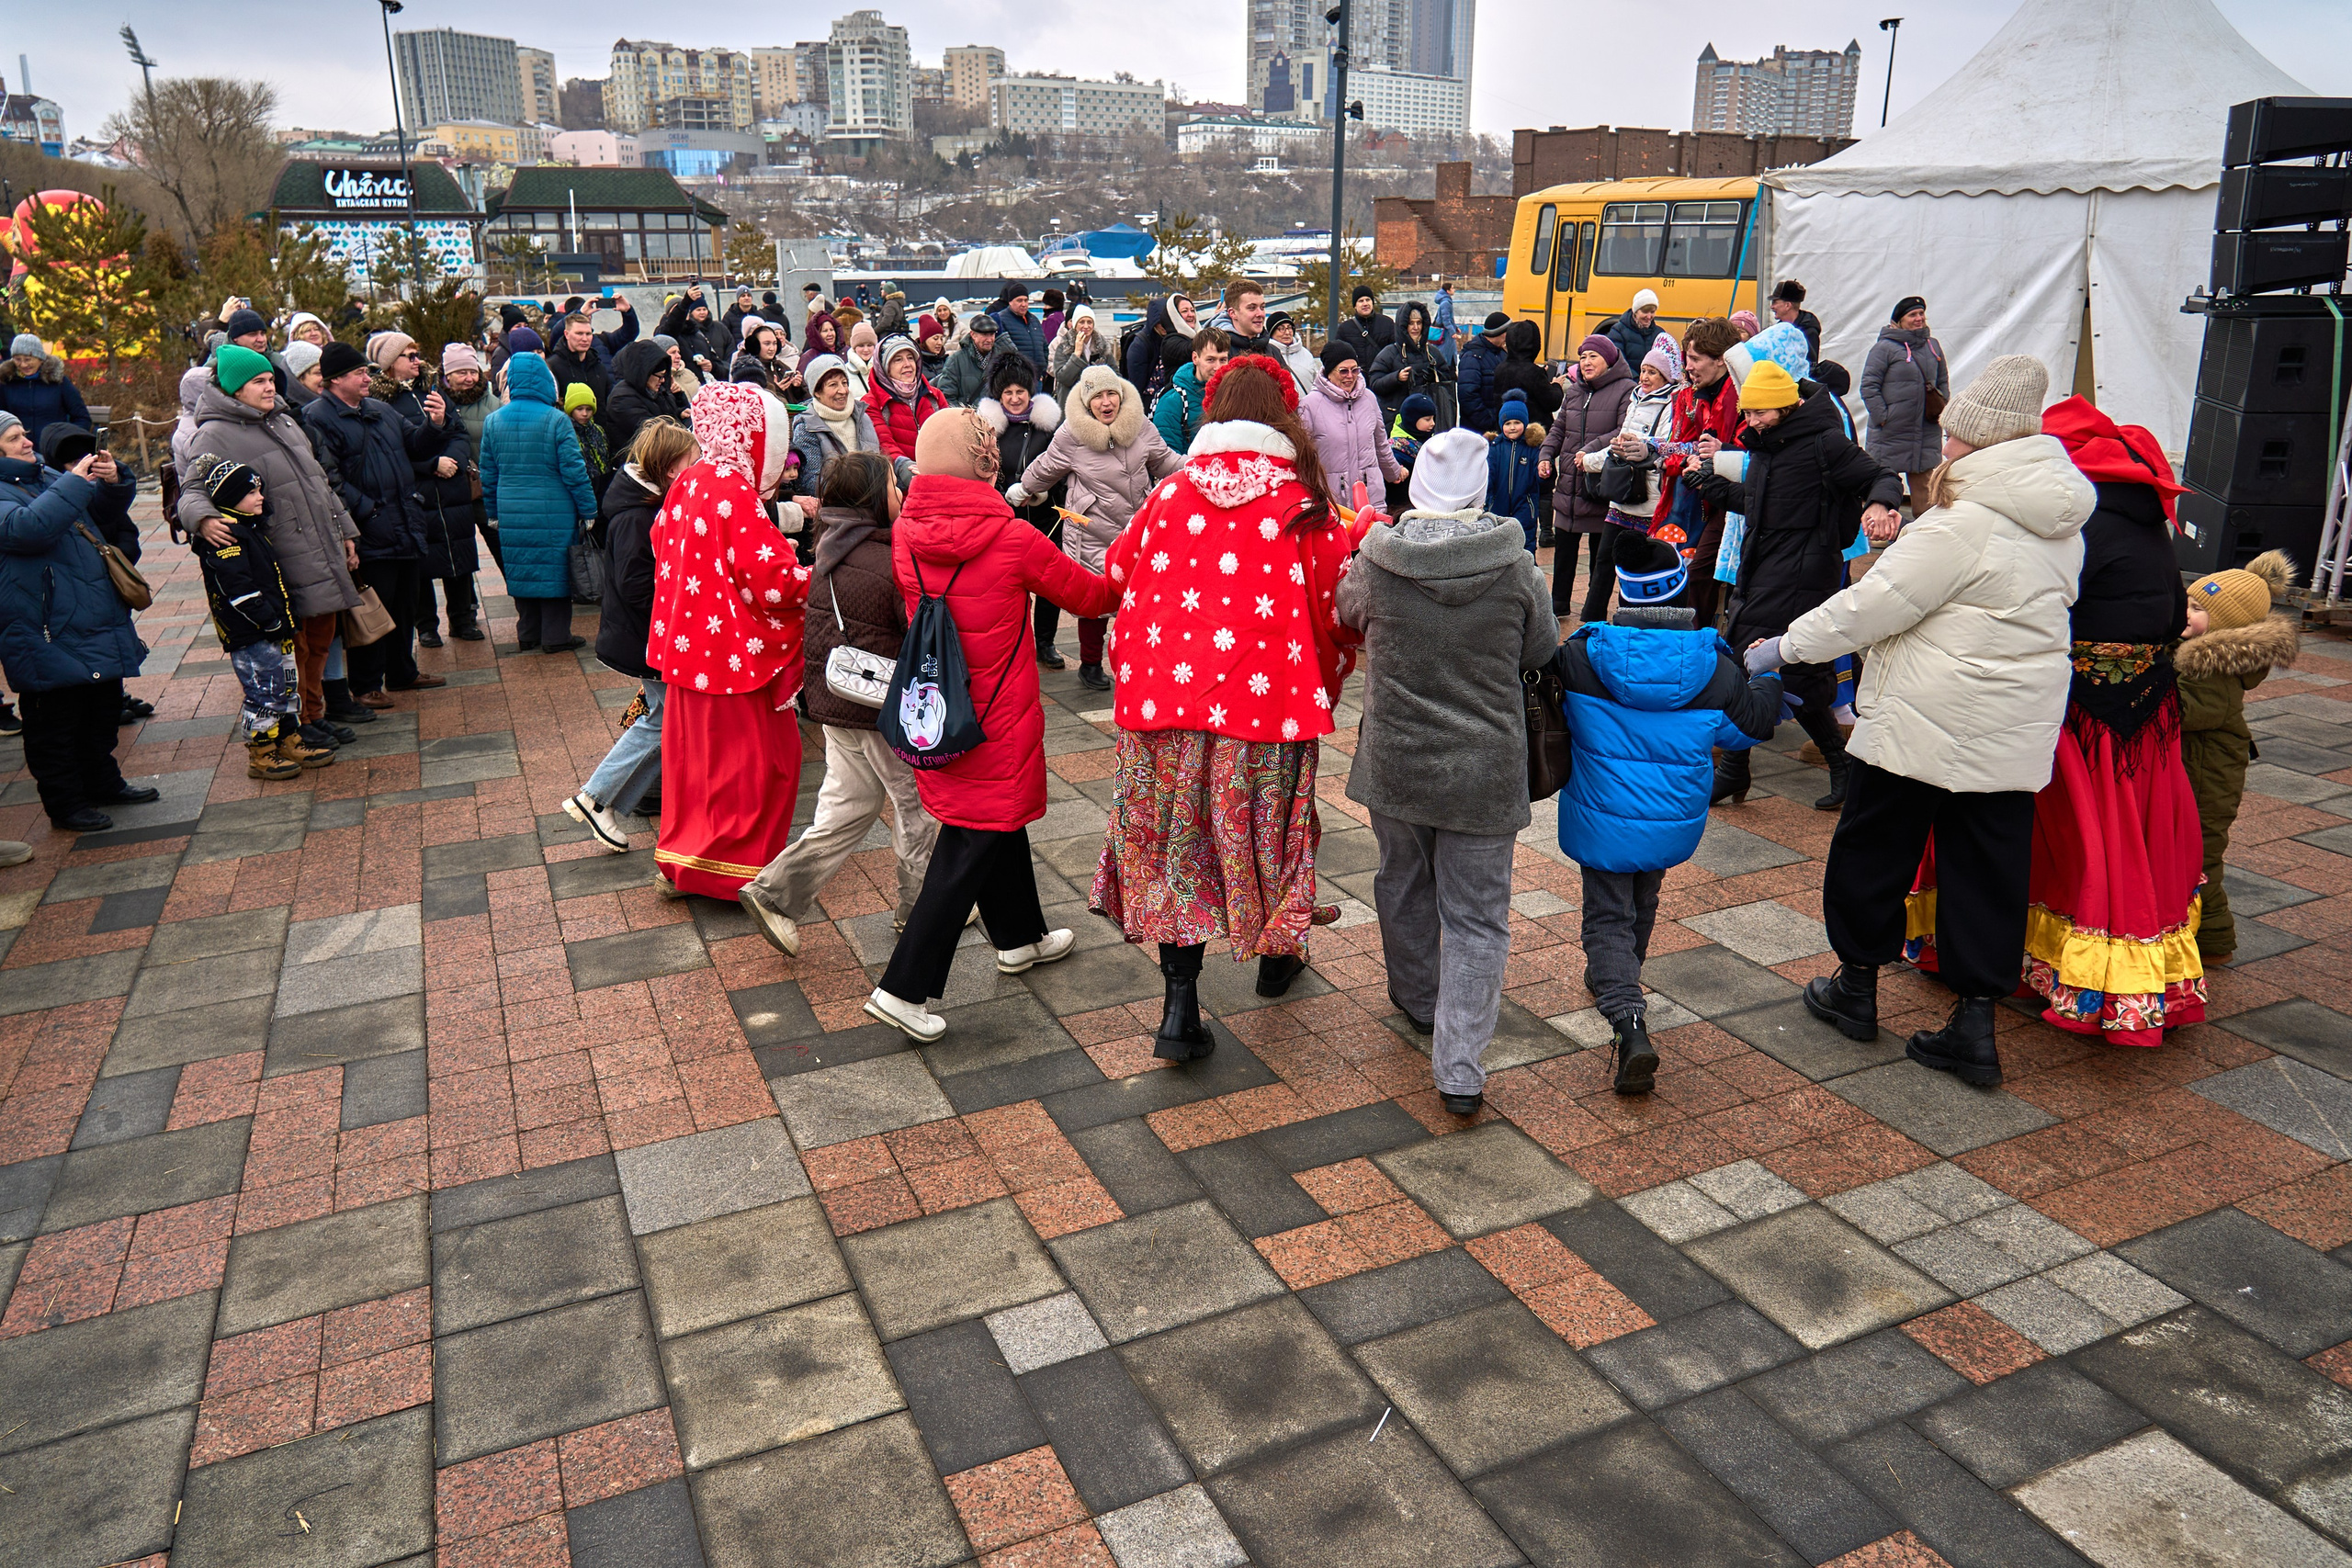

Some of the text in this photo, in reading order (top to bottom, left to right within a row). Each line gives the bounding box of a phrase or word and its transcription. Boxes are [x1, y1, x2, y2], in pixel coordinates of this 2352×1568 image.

[335, 197, 408, 208] КИТАЙСКАЯ КУХНЯ
[1663, 278, 1675, 288] 011
